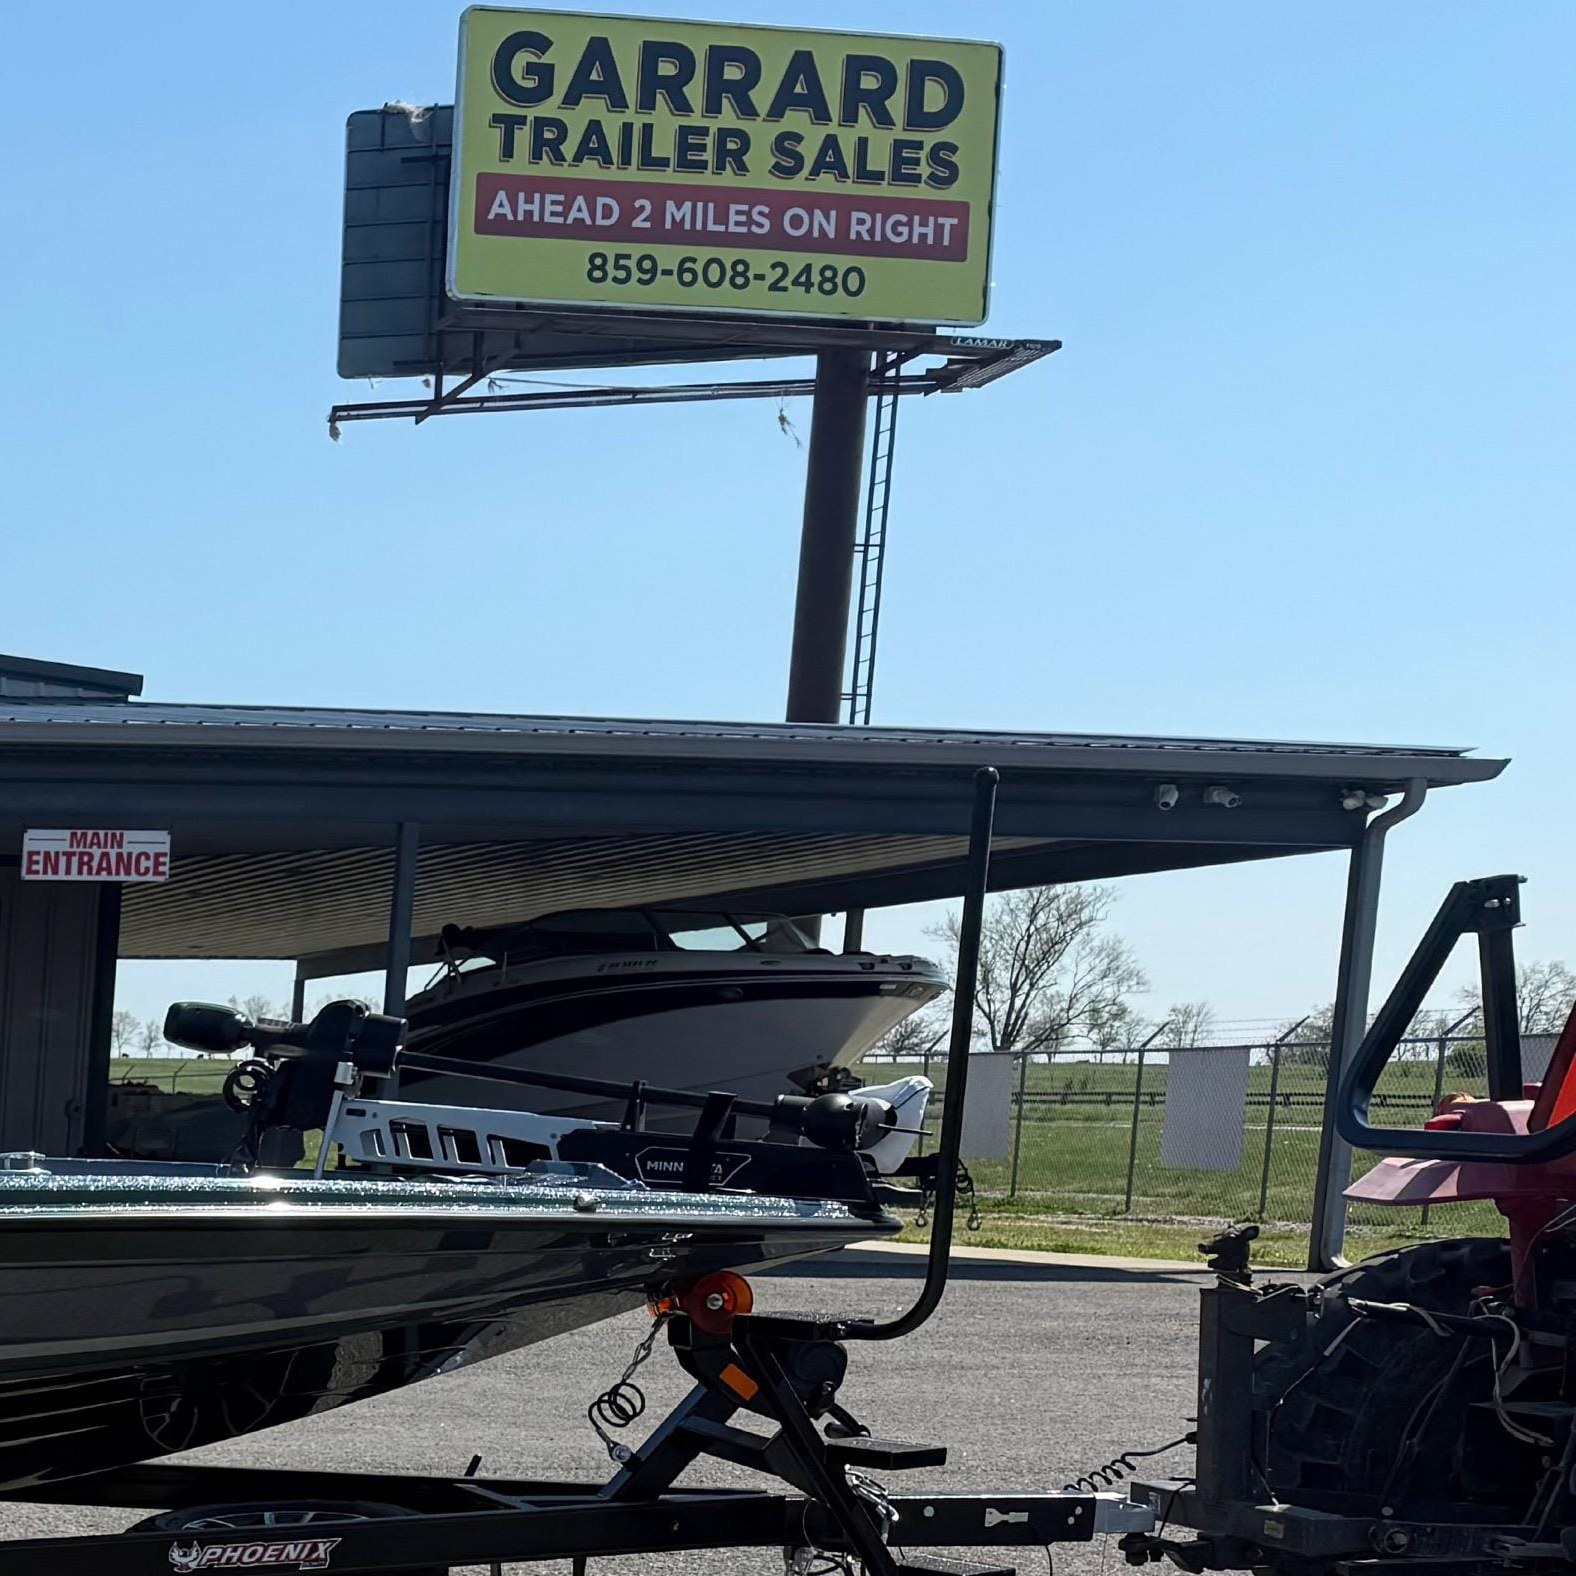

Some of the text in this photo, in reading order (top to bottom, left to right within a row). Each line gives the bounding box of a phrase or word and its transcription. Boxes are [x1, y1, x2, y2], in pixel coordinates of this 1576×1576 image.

[491, 30, 965, 132] GARRARD
[489, 113, 960, 190] TRAILER SALES
[487, 190, 959, 247] AHEAD 2 MILES ON RIGHT
[586, 251, 867, 298] 859-608-2480
[956, 337, 1009, 350] LAMAR
[69, 831, 125, 849] MAIN
[25, 850, 169, 877] ENTRANCE
[646, 1160, 684, 1172] MINN
[197, 1541, 335, 1568] PHOENIX
